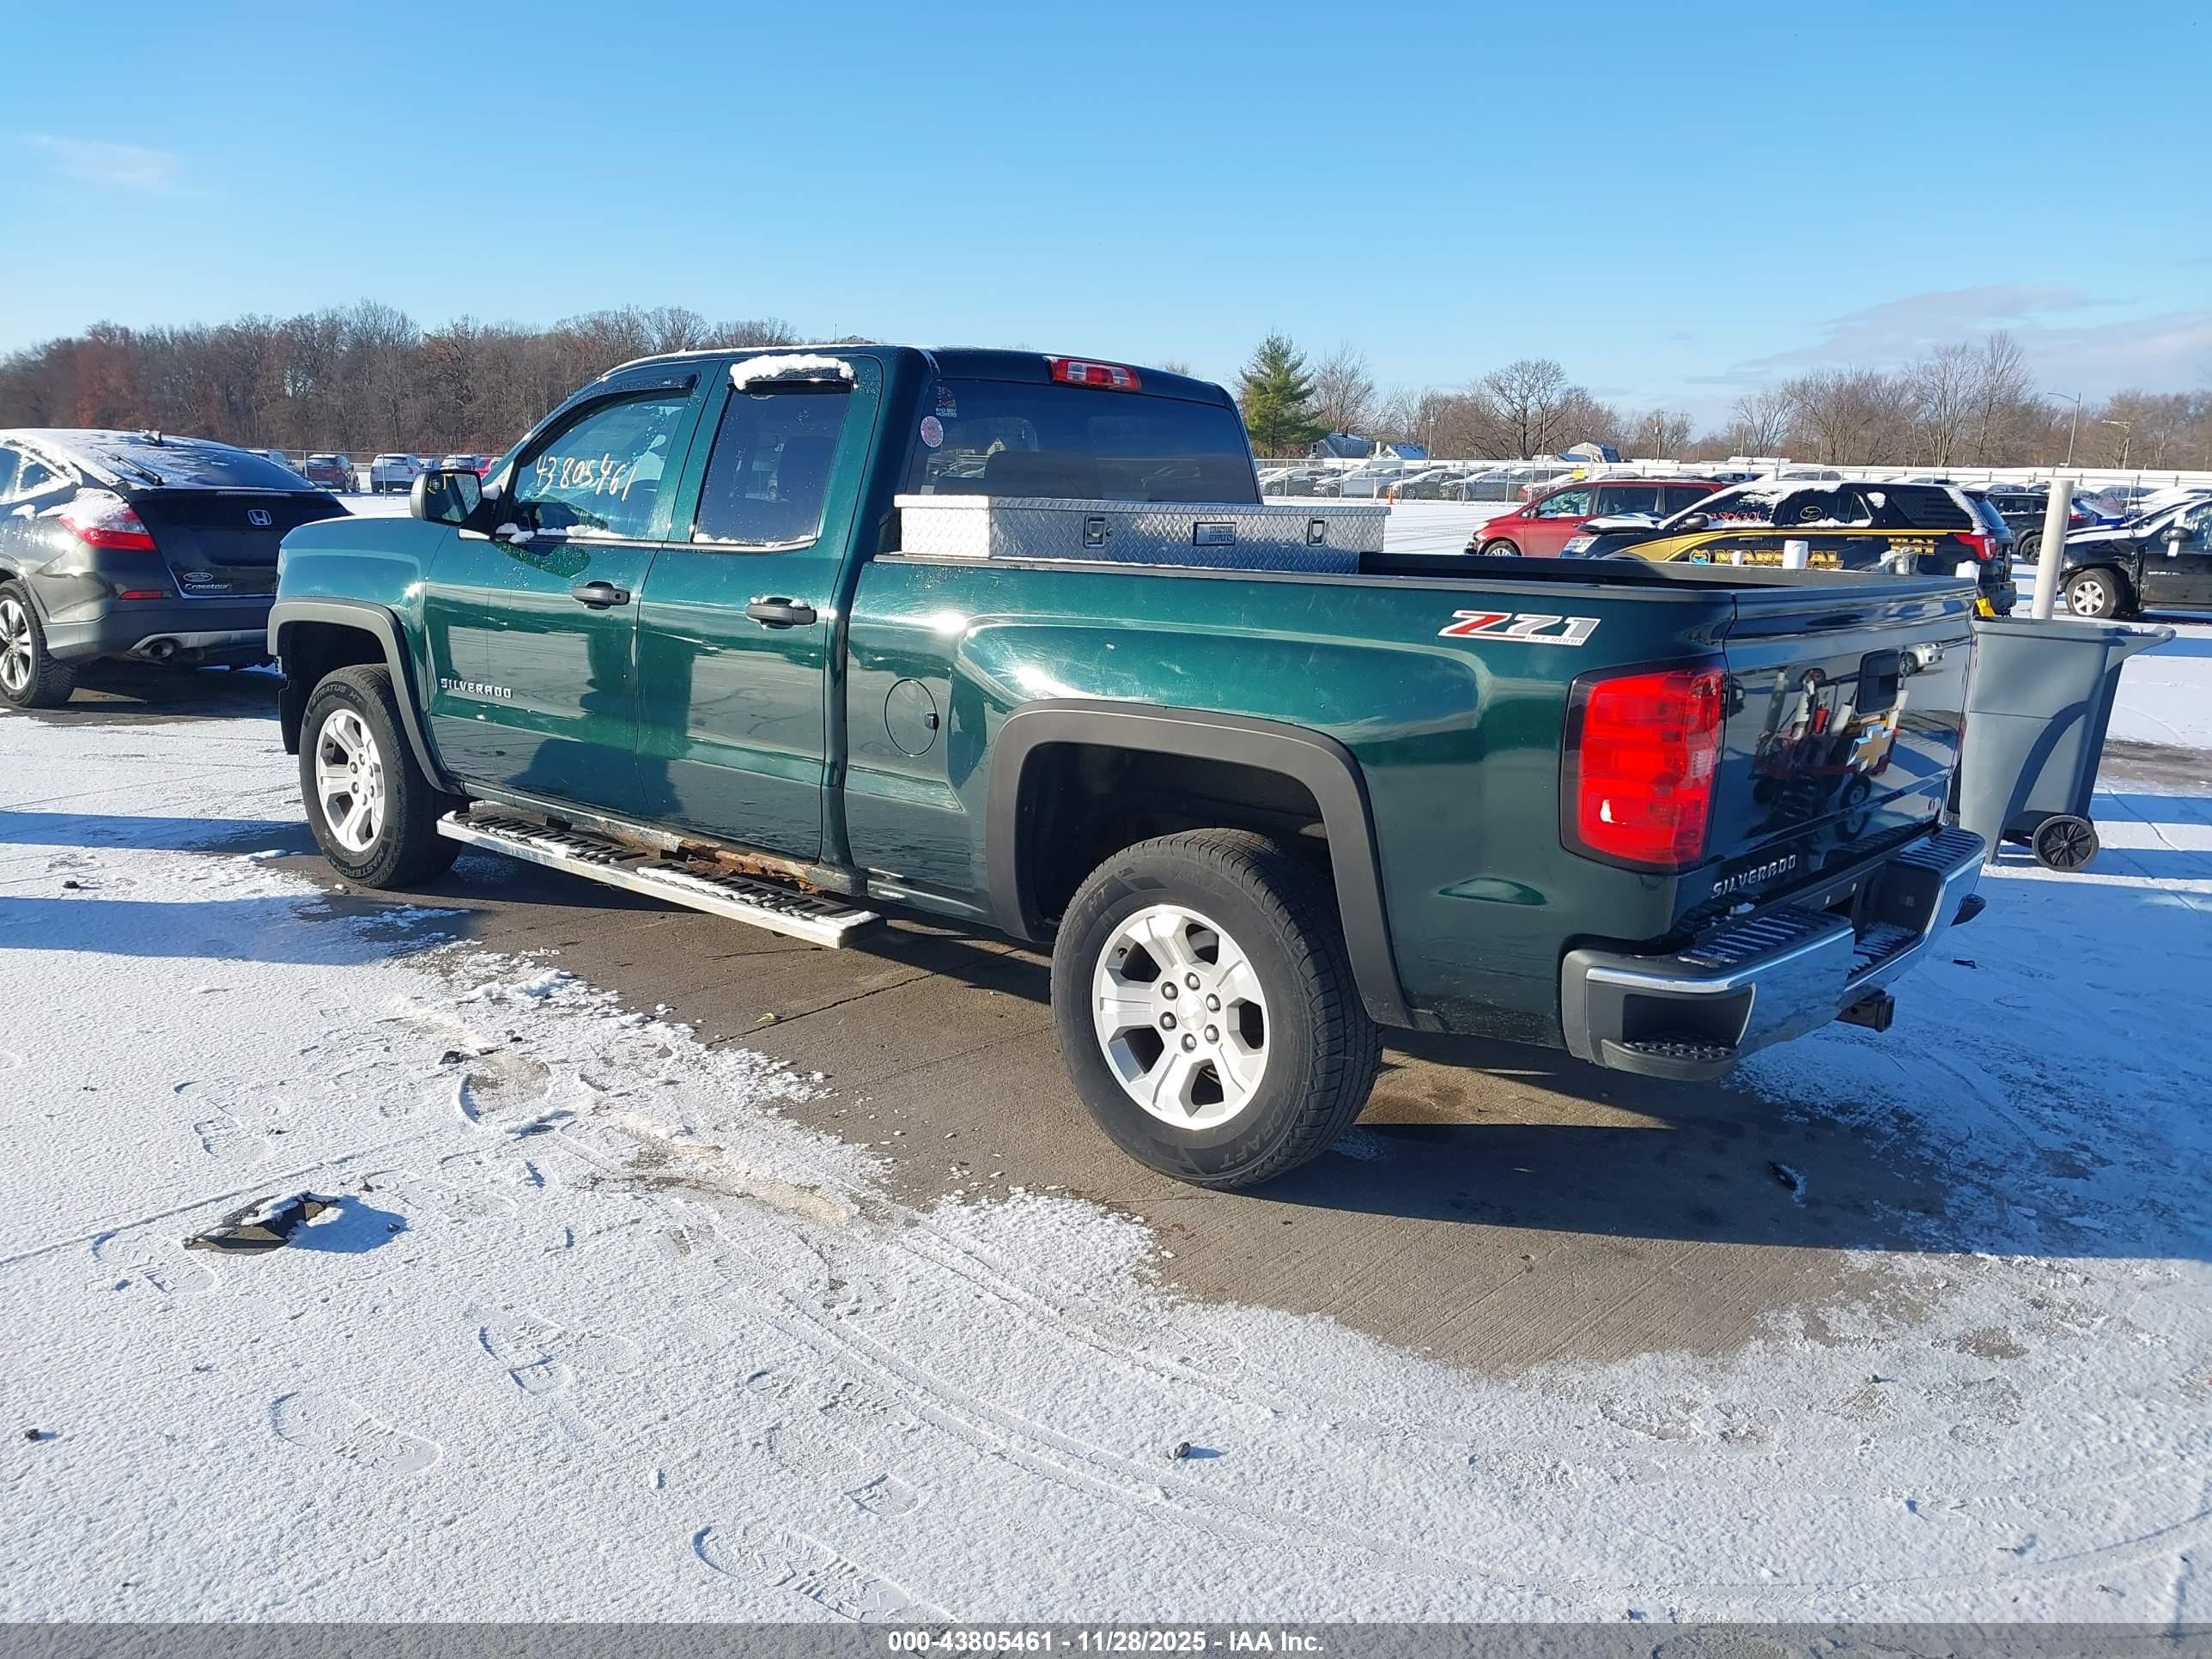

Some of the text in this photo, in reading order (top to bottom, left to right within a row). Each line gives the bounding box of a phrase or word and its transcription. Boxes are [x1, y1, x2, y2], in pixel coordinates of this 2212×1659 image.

[536, 453, 638, 502] 43805461
[1714, 549, 1844, 564] MARSAL
[1437, 610, 1601, 646] Z71
[440, 678, 513, 699] SILVERADO
[1711, 854, 1797, 899] SILVERADO
